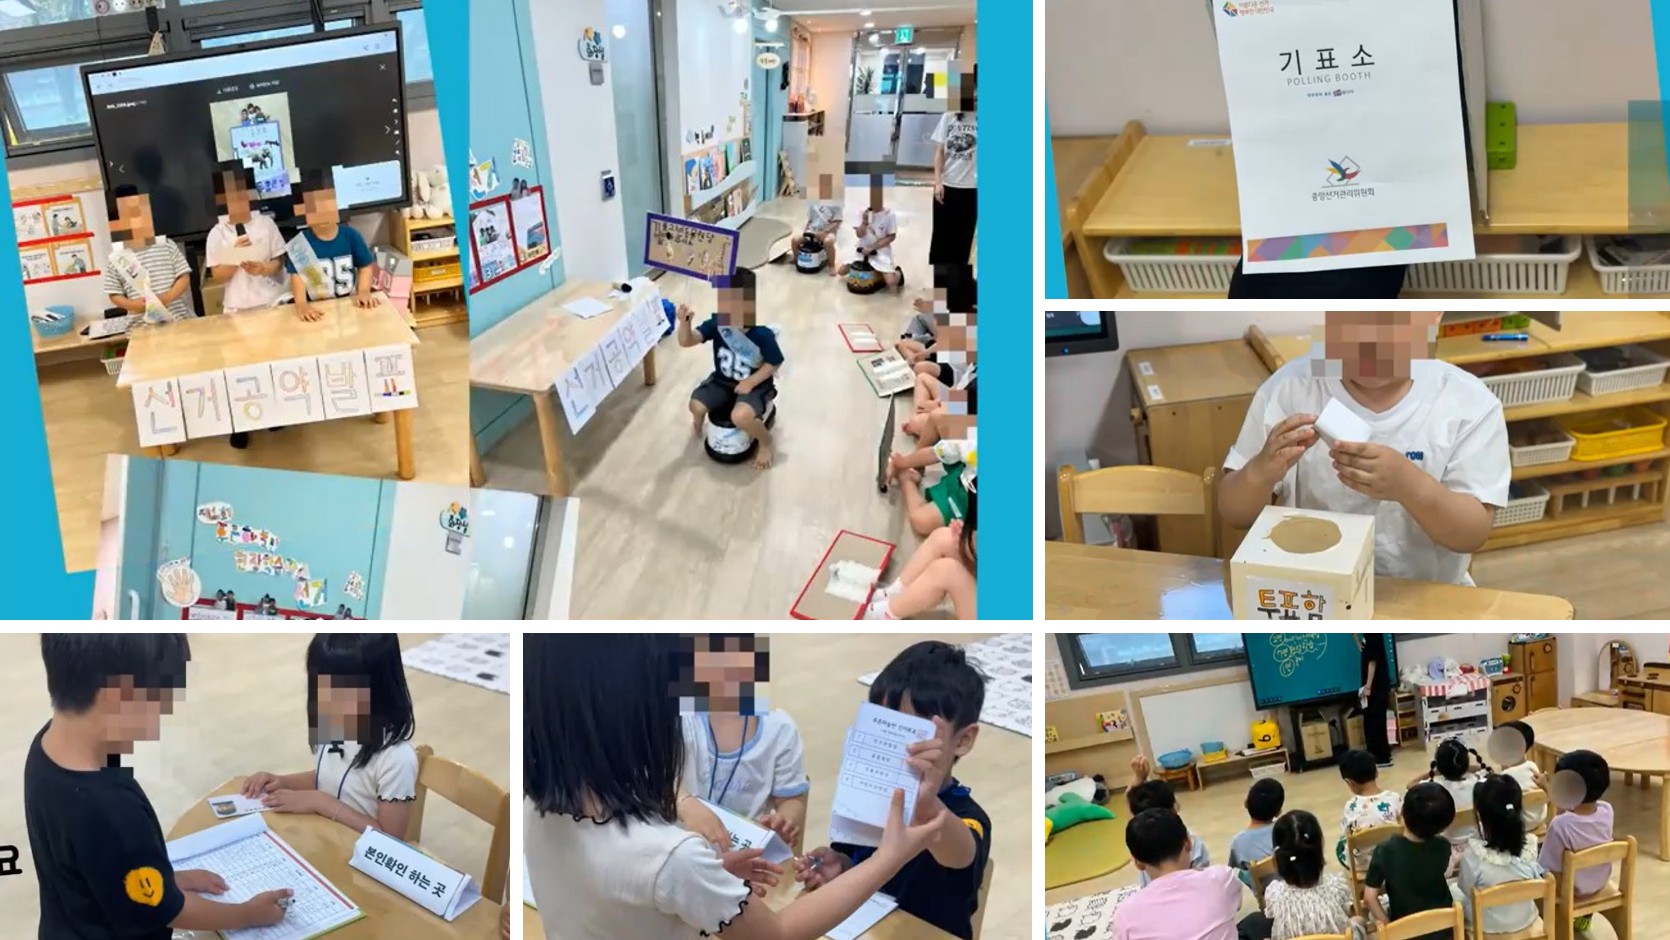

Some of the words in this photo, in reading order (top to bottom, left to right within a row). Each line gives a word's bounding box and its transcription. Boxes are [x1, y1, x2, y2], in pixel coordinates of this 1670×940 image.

[1279, 44, 1375, 75] 기표소
[1287, 74, 1331, 86] POLLING
[1335, 71, 1371, 82] BOOTH
[1311, 187, 1375, 202] 중앙선거관리위원회
[364, 846, 408, 878] 본인확인
[408, 869, 431, 890] 하는
[432, 882, 447, 898] 곳
